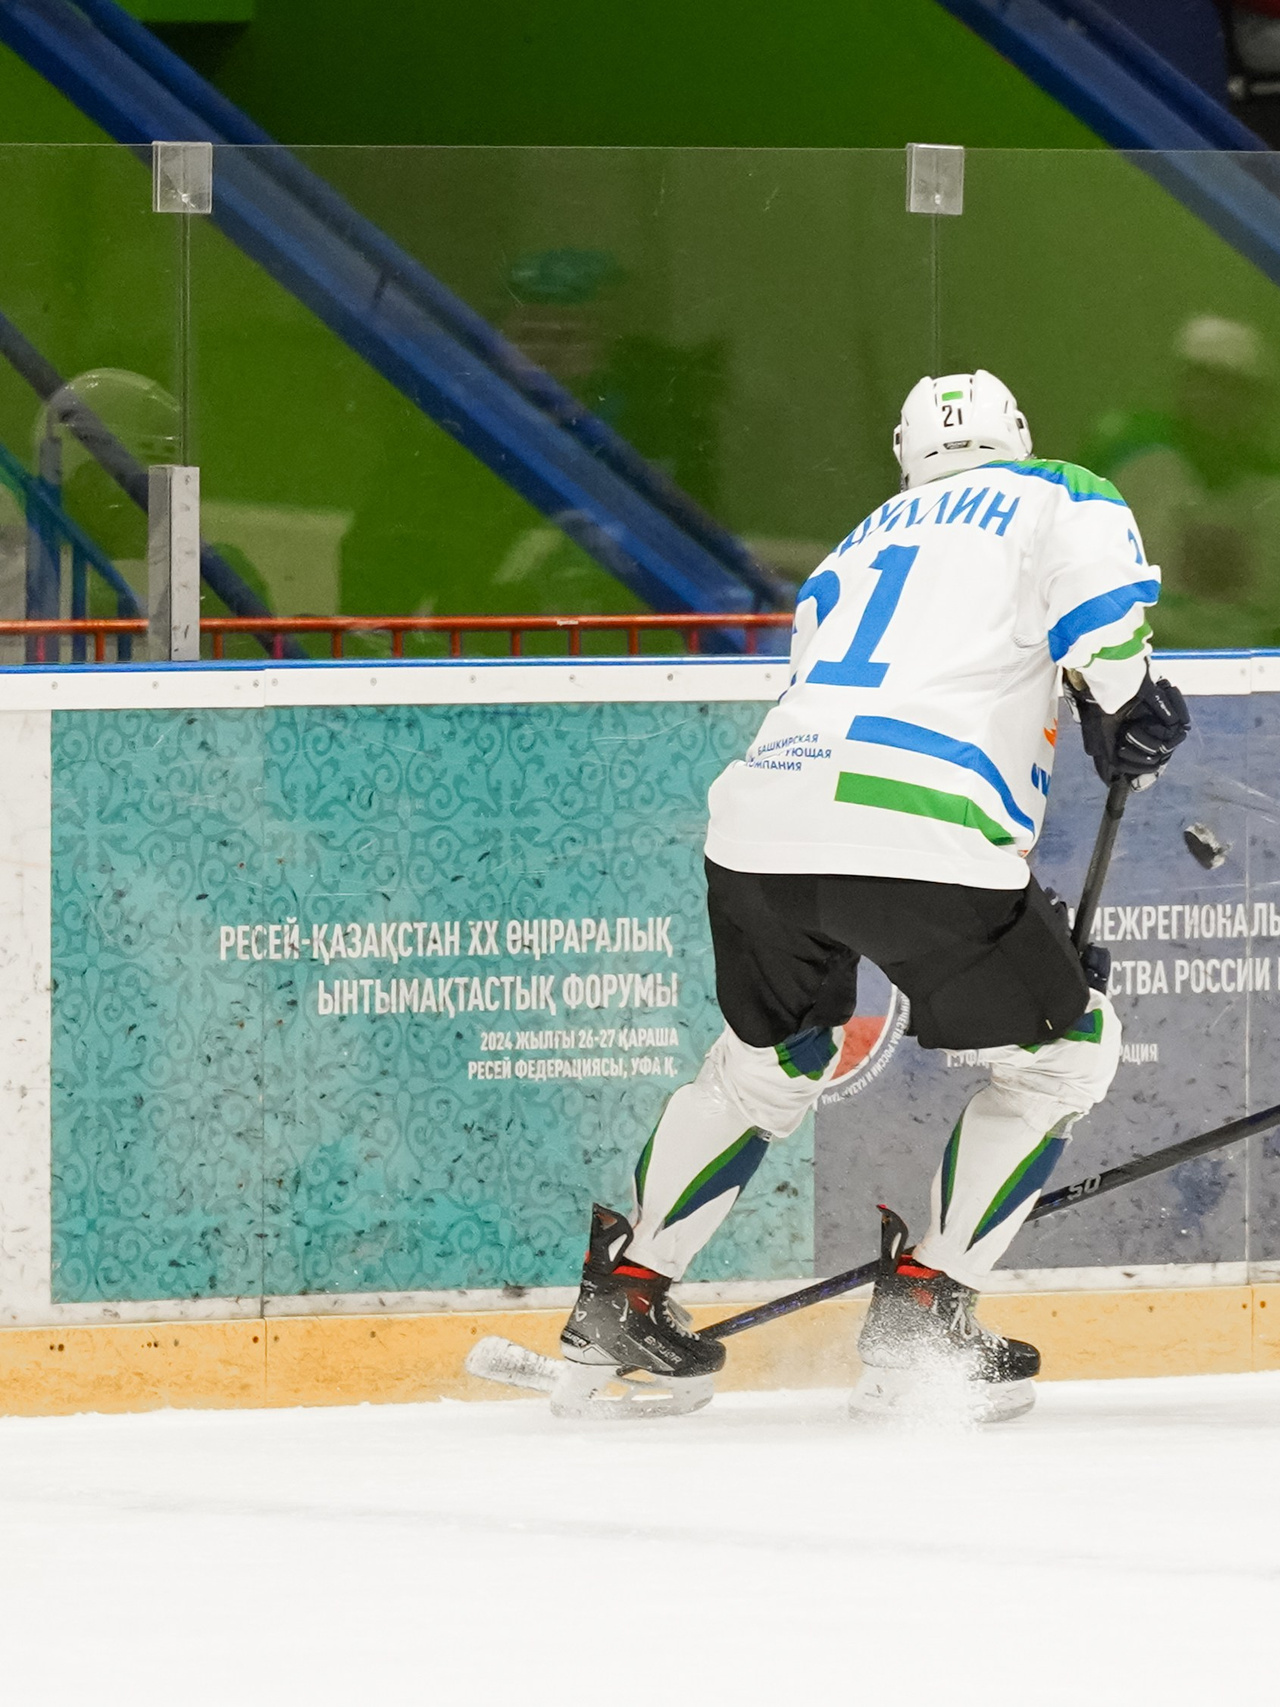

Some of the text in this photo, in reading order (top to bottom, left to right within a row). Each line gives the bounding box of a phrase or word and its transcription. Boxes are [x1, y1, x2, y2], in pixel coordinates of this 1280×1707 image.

[942, 404, 963, 427] 21
[832, 487, 1021, 557] ДУЛЛИН
[757, 733, 819, 756] БАШКИРСКАЯ
[220, 916, 460, 965] РЕСЕЙ-ҚАЗАҚСТАН
[506, 916, 673, 960] ӨҢІРАРАЛЫҚ
[1174, 957, 1270, 994] РОССИИ
[318, 972, 678, 1018] ЫНТЫМАҚТАСТЫҚ ФОРУМЫ
[480, 1031, 513, 1051] 2024
[578, 1029, 615, 1048] 26-27
[618, 1027, 679, 1051] ҚАРАША
[468, 1056, 511, 1080] РЕСЕЙ
[514, 1057, 627, 1082] ФЕДЕРАЦИЯСЫ,
[631, 1056, 661, 1076] УФА
[821, 1076, 867, 1105] КАЗАТАНА
